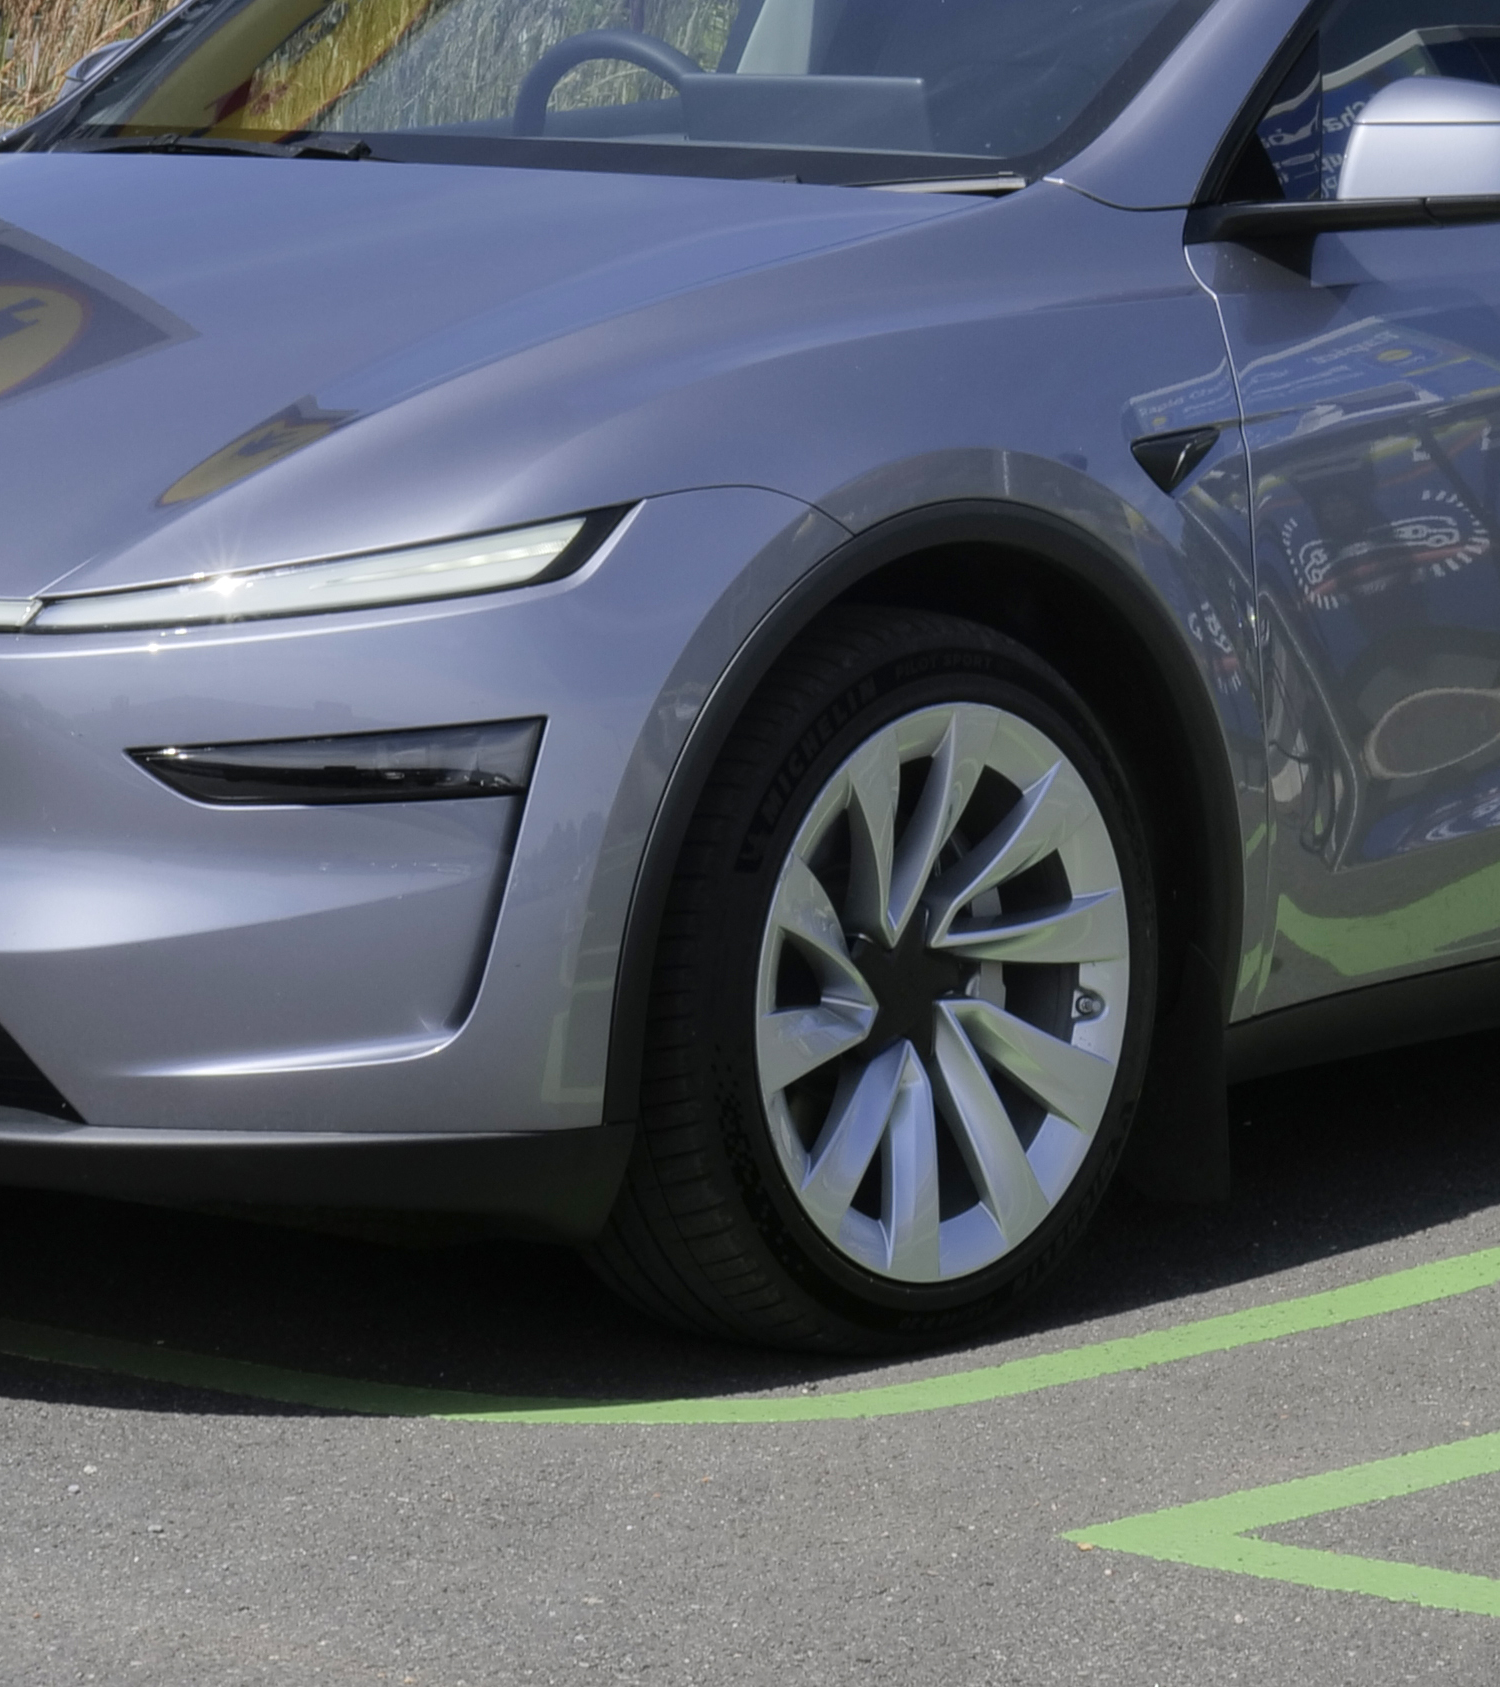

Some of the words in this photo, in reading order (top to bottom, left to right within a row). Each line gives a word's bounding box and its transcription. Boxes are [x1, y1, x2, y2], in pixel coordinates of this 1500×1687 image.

[761, 674, 877, 825] MICHELIN
[895, 653, 937, 681] PILOT
[942, 653, 993, 671] SPORT
